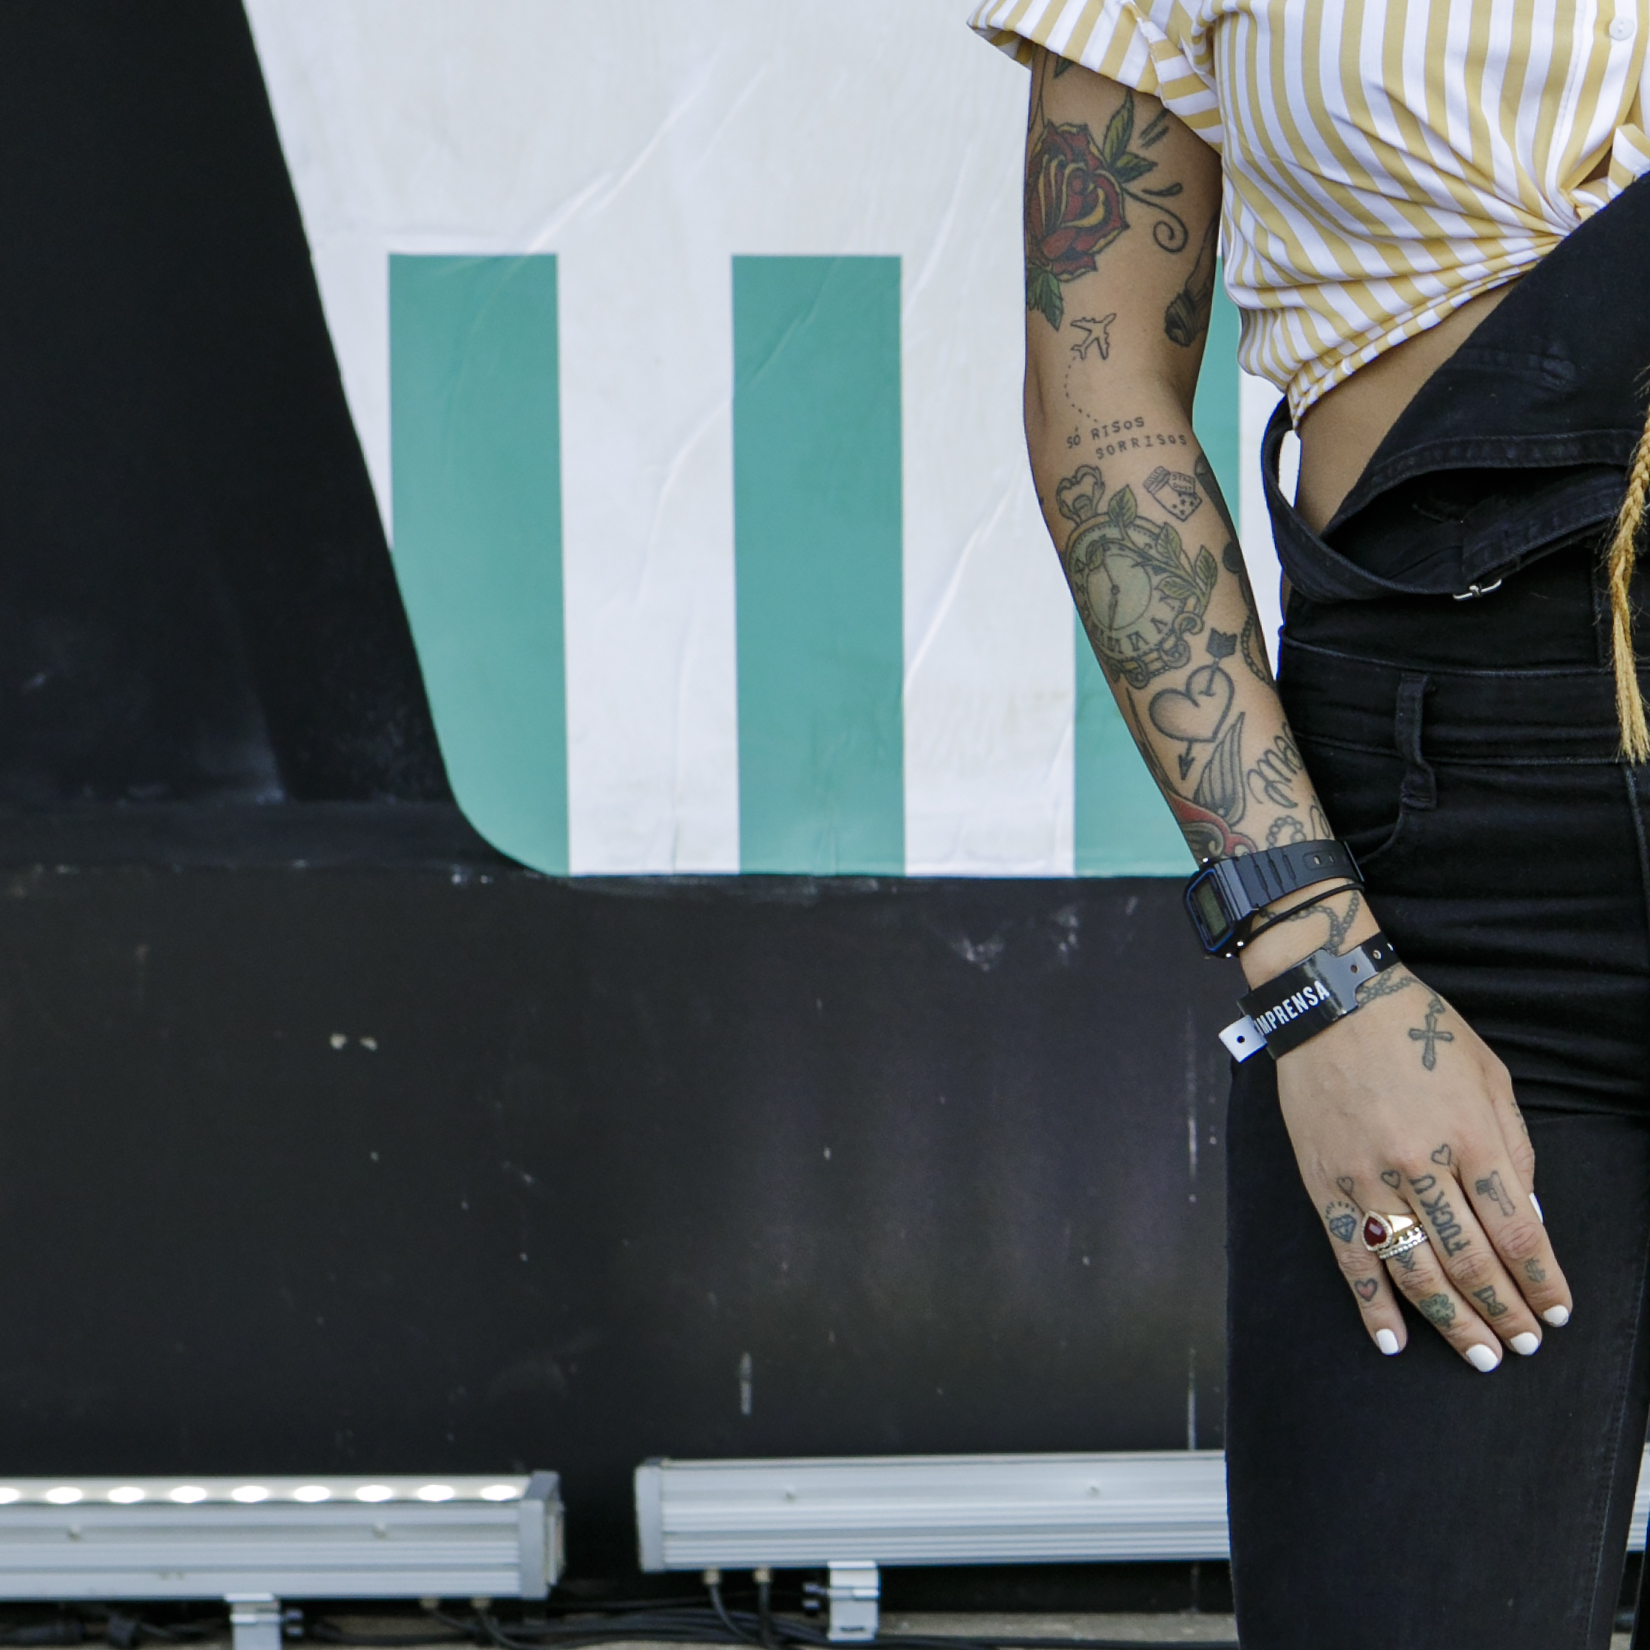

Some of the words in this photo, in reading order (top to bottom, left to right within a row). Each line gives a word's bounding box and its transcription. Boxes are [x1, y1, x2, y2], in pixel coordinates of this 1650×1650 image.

[1090, 416, 1145, 441] RISOS
[1095, 434, 1187, 460] SORRISOS
[1253, 980, 1330, 1036] IMPRENSA
[1420, 1191, 1471, 1257] FUCK
